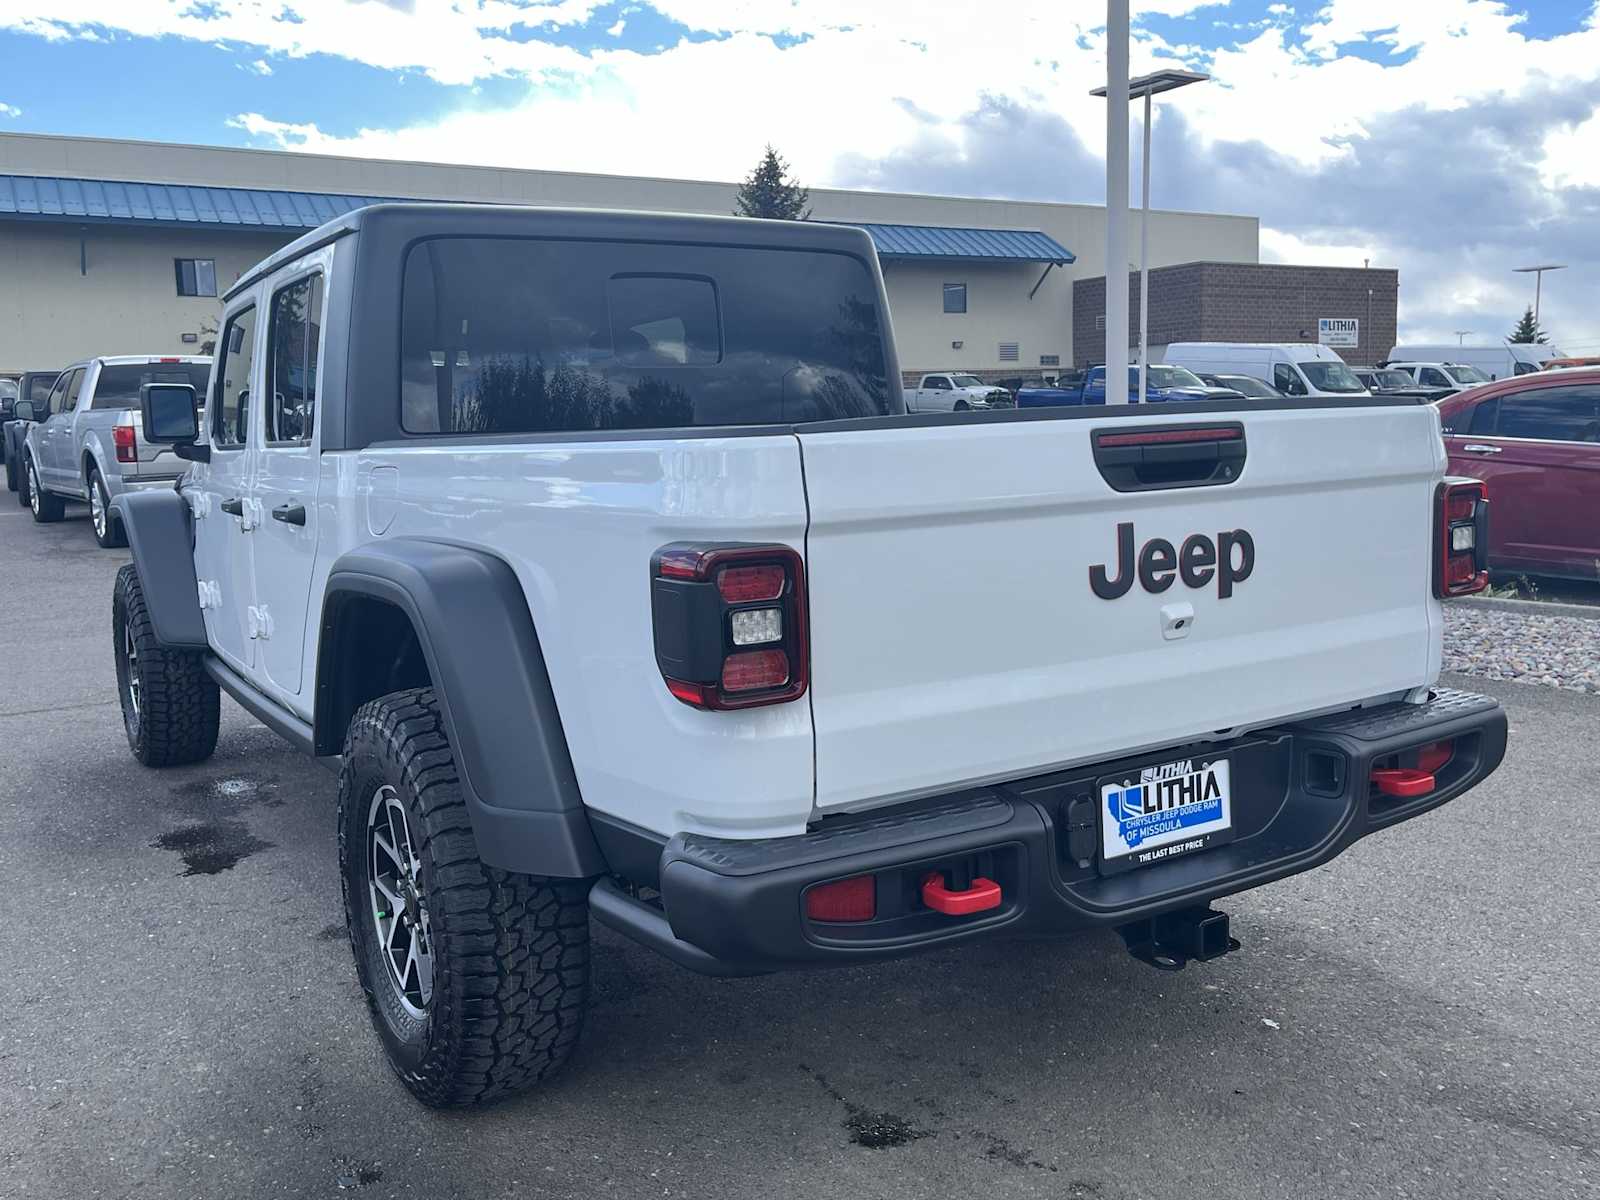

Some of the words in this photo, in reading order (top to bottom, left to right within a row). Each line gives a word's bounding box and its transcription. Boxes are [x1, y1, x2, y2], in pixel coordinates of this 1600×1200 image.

[1328, 320, 1356, 331] LITHIA
[1089, 522, 1255, 600] Jeep
[1152, 760, 1193, 779] LITHIA
[1143, 770, 1220, 814] LITHIA
[1126, 812, 1161, 829] CHRYSLER
[1162, 809, 1179, 822] JEEP
[1179, 803, 1202, 815] DODGE
[1203, 800, 1218, 811] RAM
[1126, 828, 1138, 841] OF
[1139, 819, 1182, 838] MISSOULA
[1139, 853, 1152, 863] THE
[1152, 849, 1168, 859] LAST
[1169, 844, 1185, 856] BEST
[1185, 840, 1203, 851] PRICE
